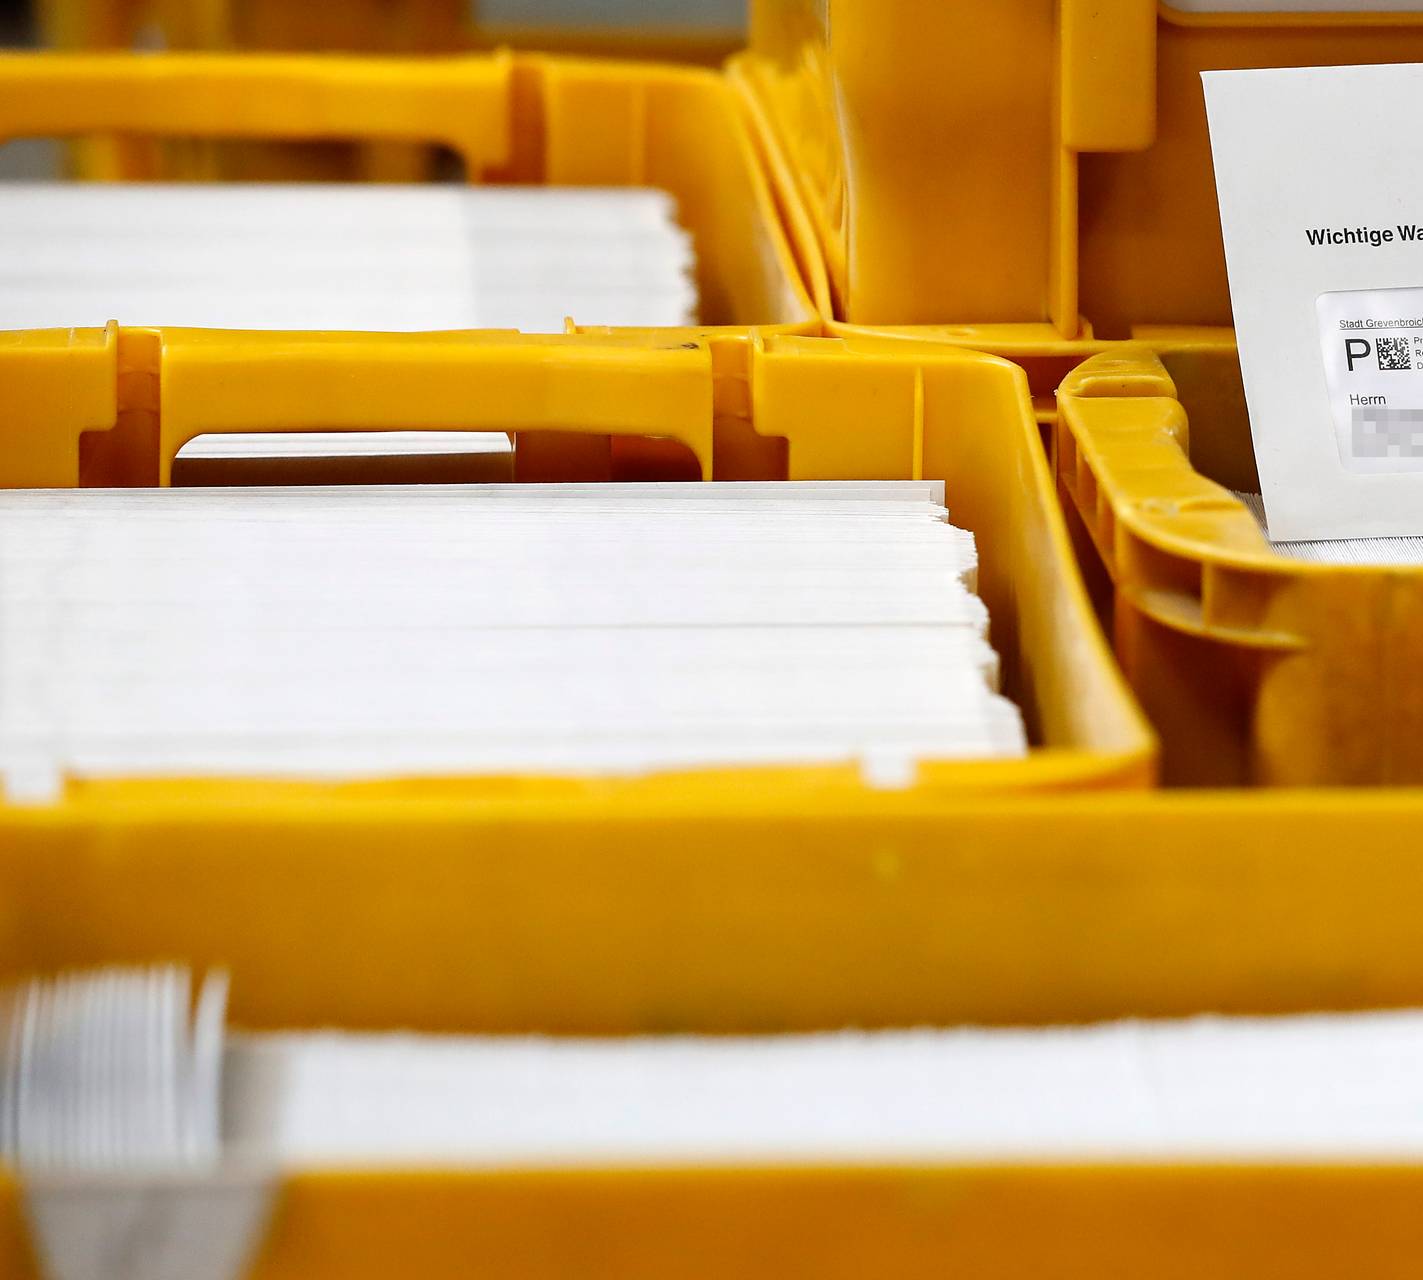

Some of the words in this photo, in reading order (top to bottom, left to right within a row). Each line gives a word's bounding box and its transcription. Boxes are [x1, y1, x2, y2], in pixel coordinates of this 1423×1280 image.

[1305, 228, 1394, 247] Wichtige
[1339, 319, 1363, 329] Stadt
[1345, 338, 1371, 371] P
[1349, 393, 1386, 406] Herrn
